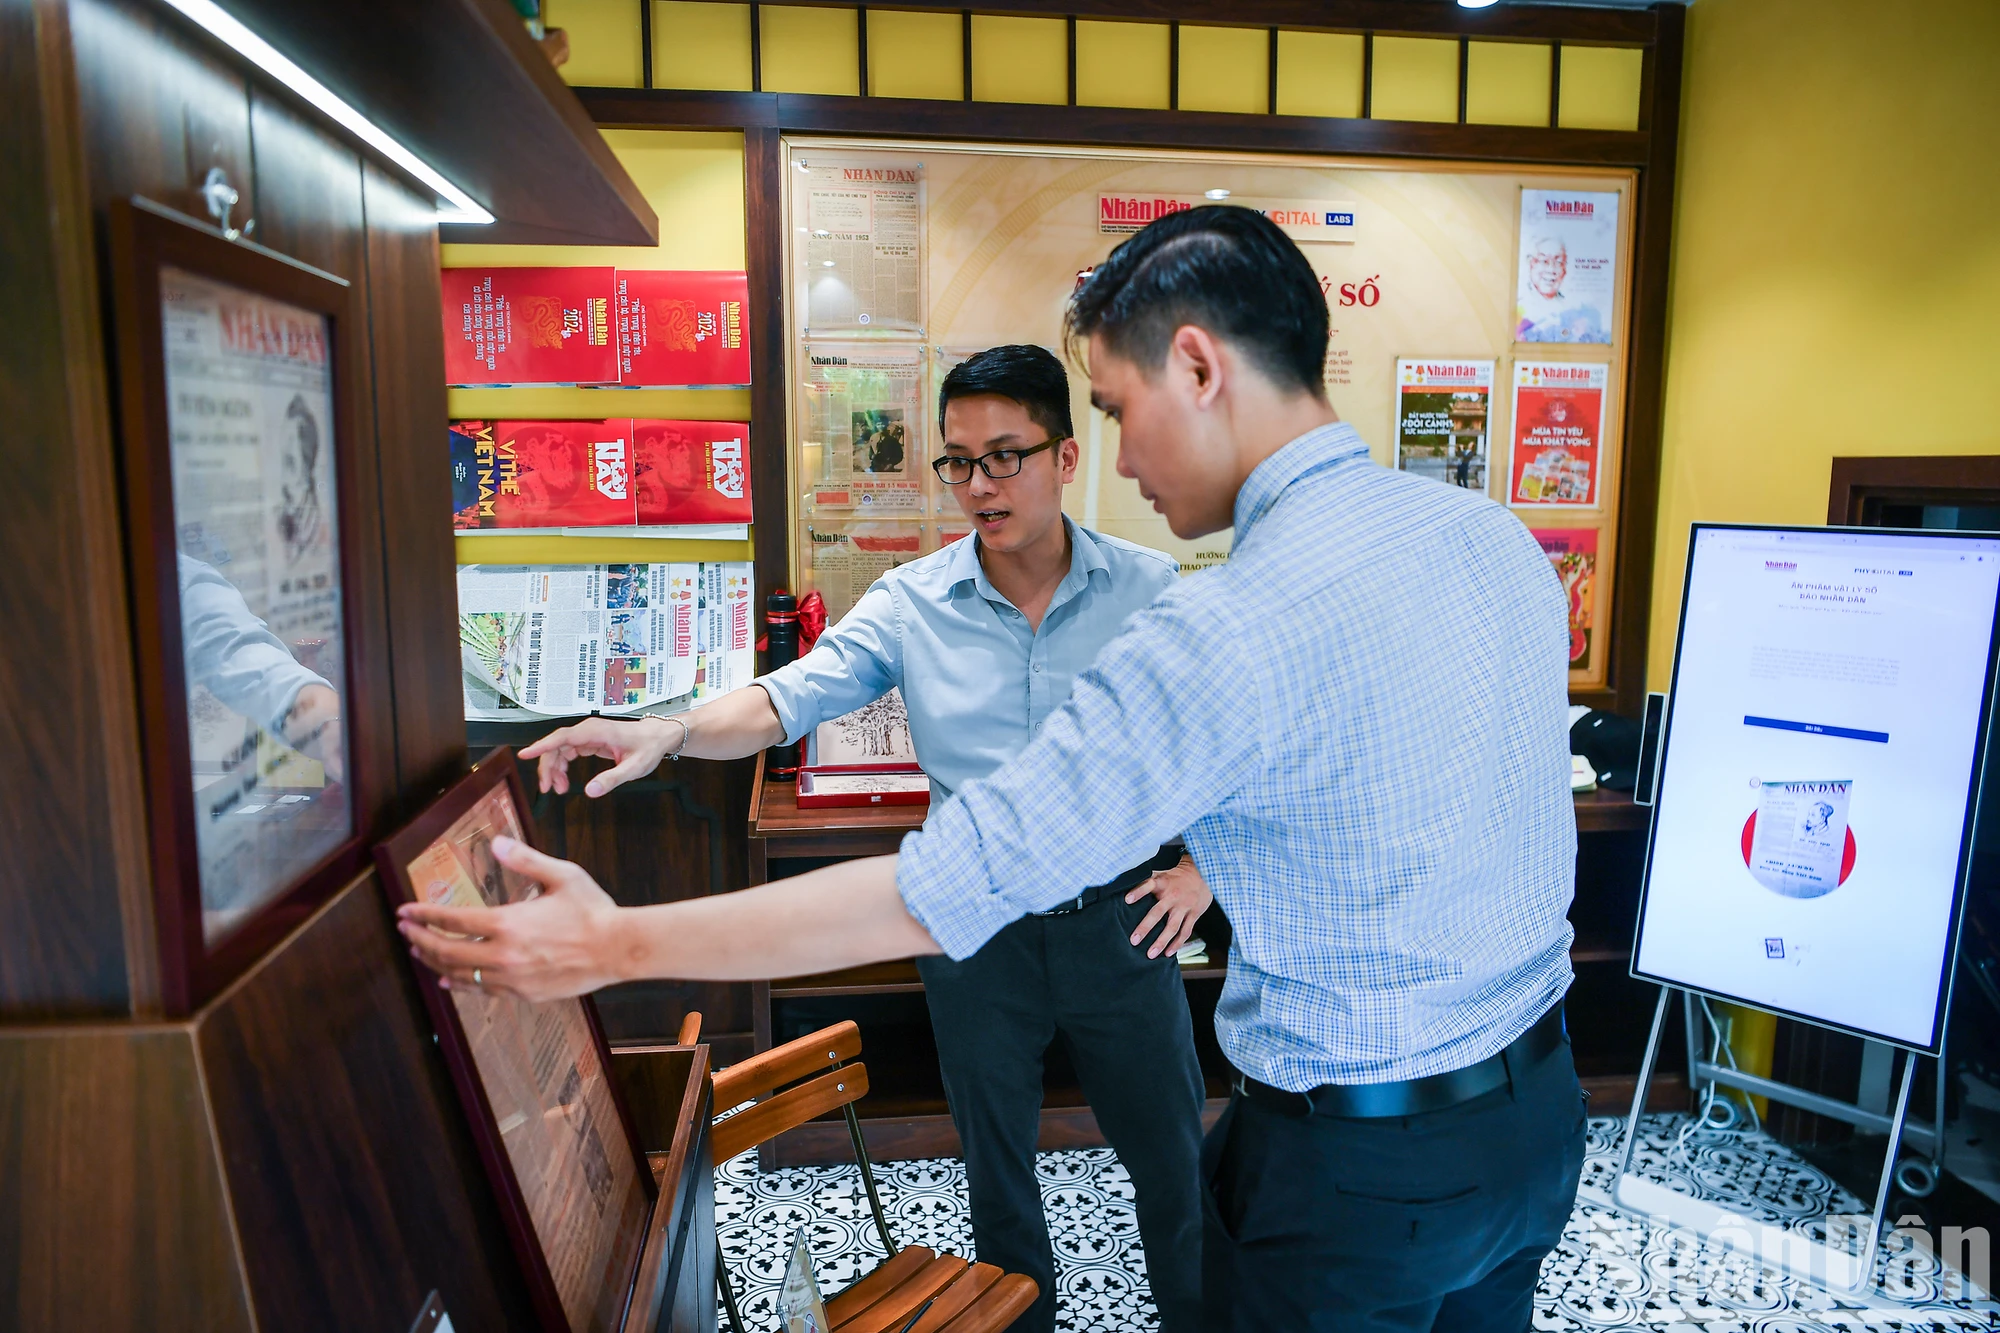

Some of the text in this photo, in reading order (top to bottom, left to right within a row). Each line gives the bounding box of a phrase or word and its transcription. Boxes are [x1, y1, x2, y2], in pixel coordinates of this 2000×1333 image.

[1102, 198, 1151, 219] Nhân
[1546, 200, 1594, 213] Nhân Dân
[1339, 275, 1380, 307] SỐ
[563, 309, 579, 333] 2024
[596, 298, 608, 345] Nhân Dân
[698, 312, 712, 336] 2024
[730, 302, 741, 348] Nhân Dân
[811, 356, 847, 365] Nhân Dân
[1427, 365, 1454, 376] Nhân
[1456, 366, 1476, 376] Dân
[1543, 368, 1590, 379] Nhân Dân
[474, 426, 496, 516] VIỆT NAM
[500, 461, 521, 495] THẾ
[595, 443, 612, 499] NAY
[712, 442, 729, 498] NAY
[833, 534, 848, 542] Dân
[1196, 551, 1225, 559] HƯỚNG
[678, 604, 691, 657] Nhân Dân
[735, 602, 748, 650] Nhân Dân
